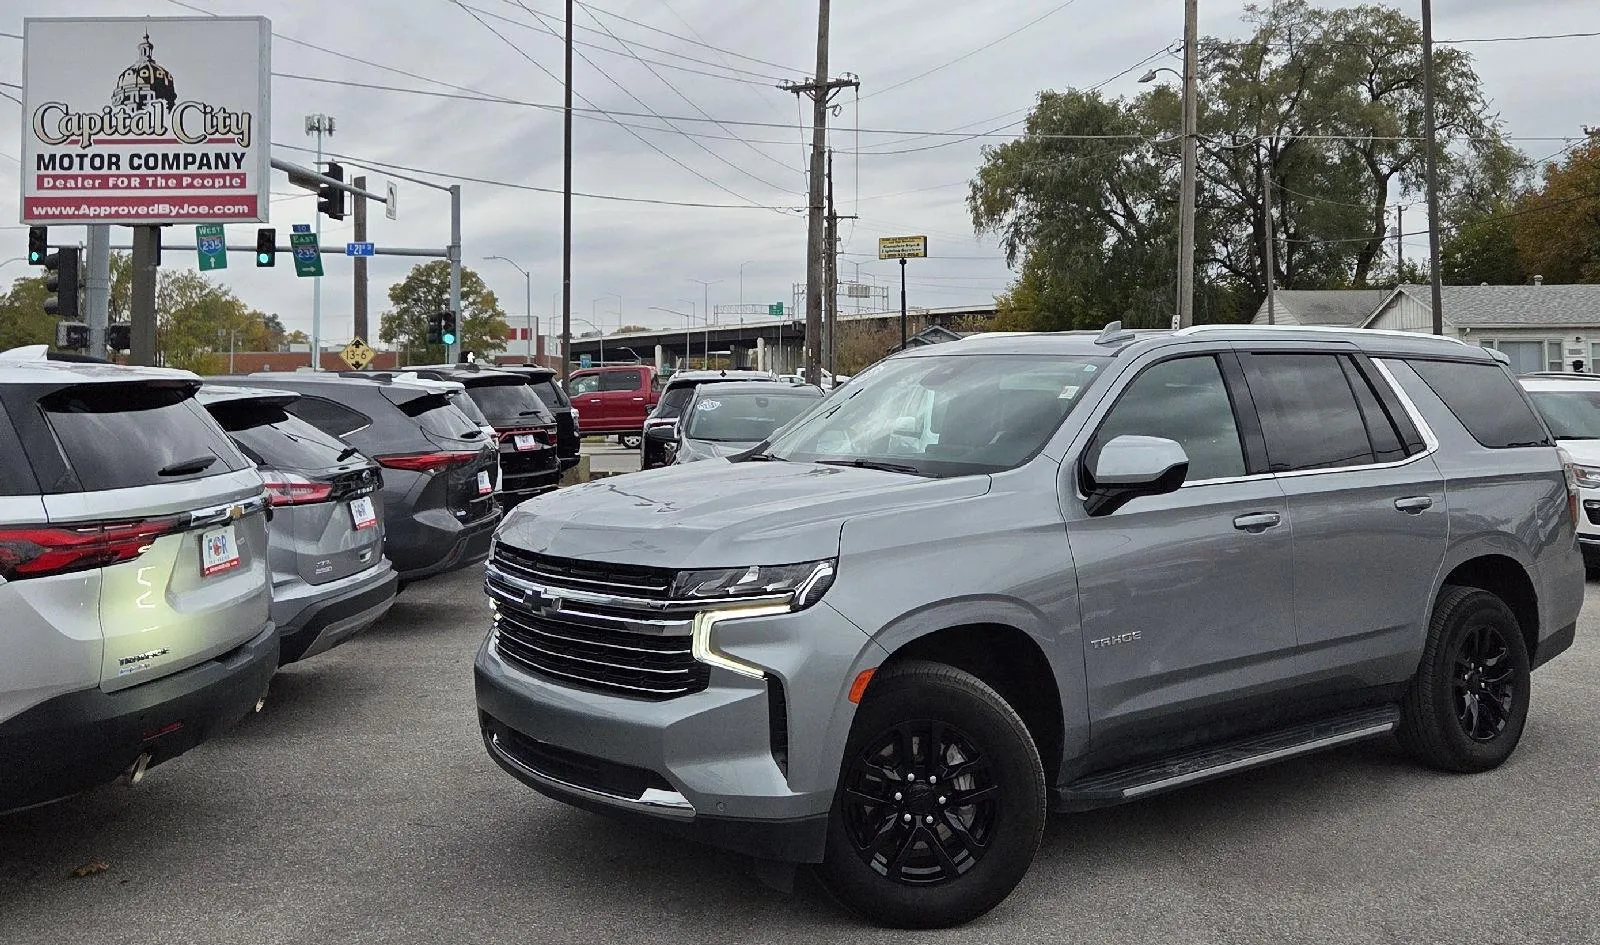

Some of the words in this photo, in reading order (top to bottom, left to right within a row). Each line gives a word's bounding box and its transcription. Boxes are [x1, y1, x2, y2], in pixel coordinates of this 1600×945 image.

[33, 101, 168, 149] Capital
[172, 101, 252, 148] City
[36, 153, 121, 171] MOTOR
[129, 152, 246, 171] COMPANY
[43, 176, 102, 188] Dealer
[108, 176, 140, 187] FOR
[146, 176, 177, 187] The
[182, 175, 241, 188] People
[32, 203, 249, 217] www.ApprovedByJoe.com
[202, 240, 222, 251] 235
[297, 248, 316, 258] 235
[1091, 630, 1142, 650] TAHOE
